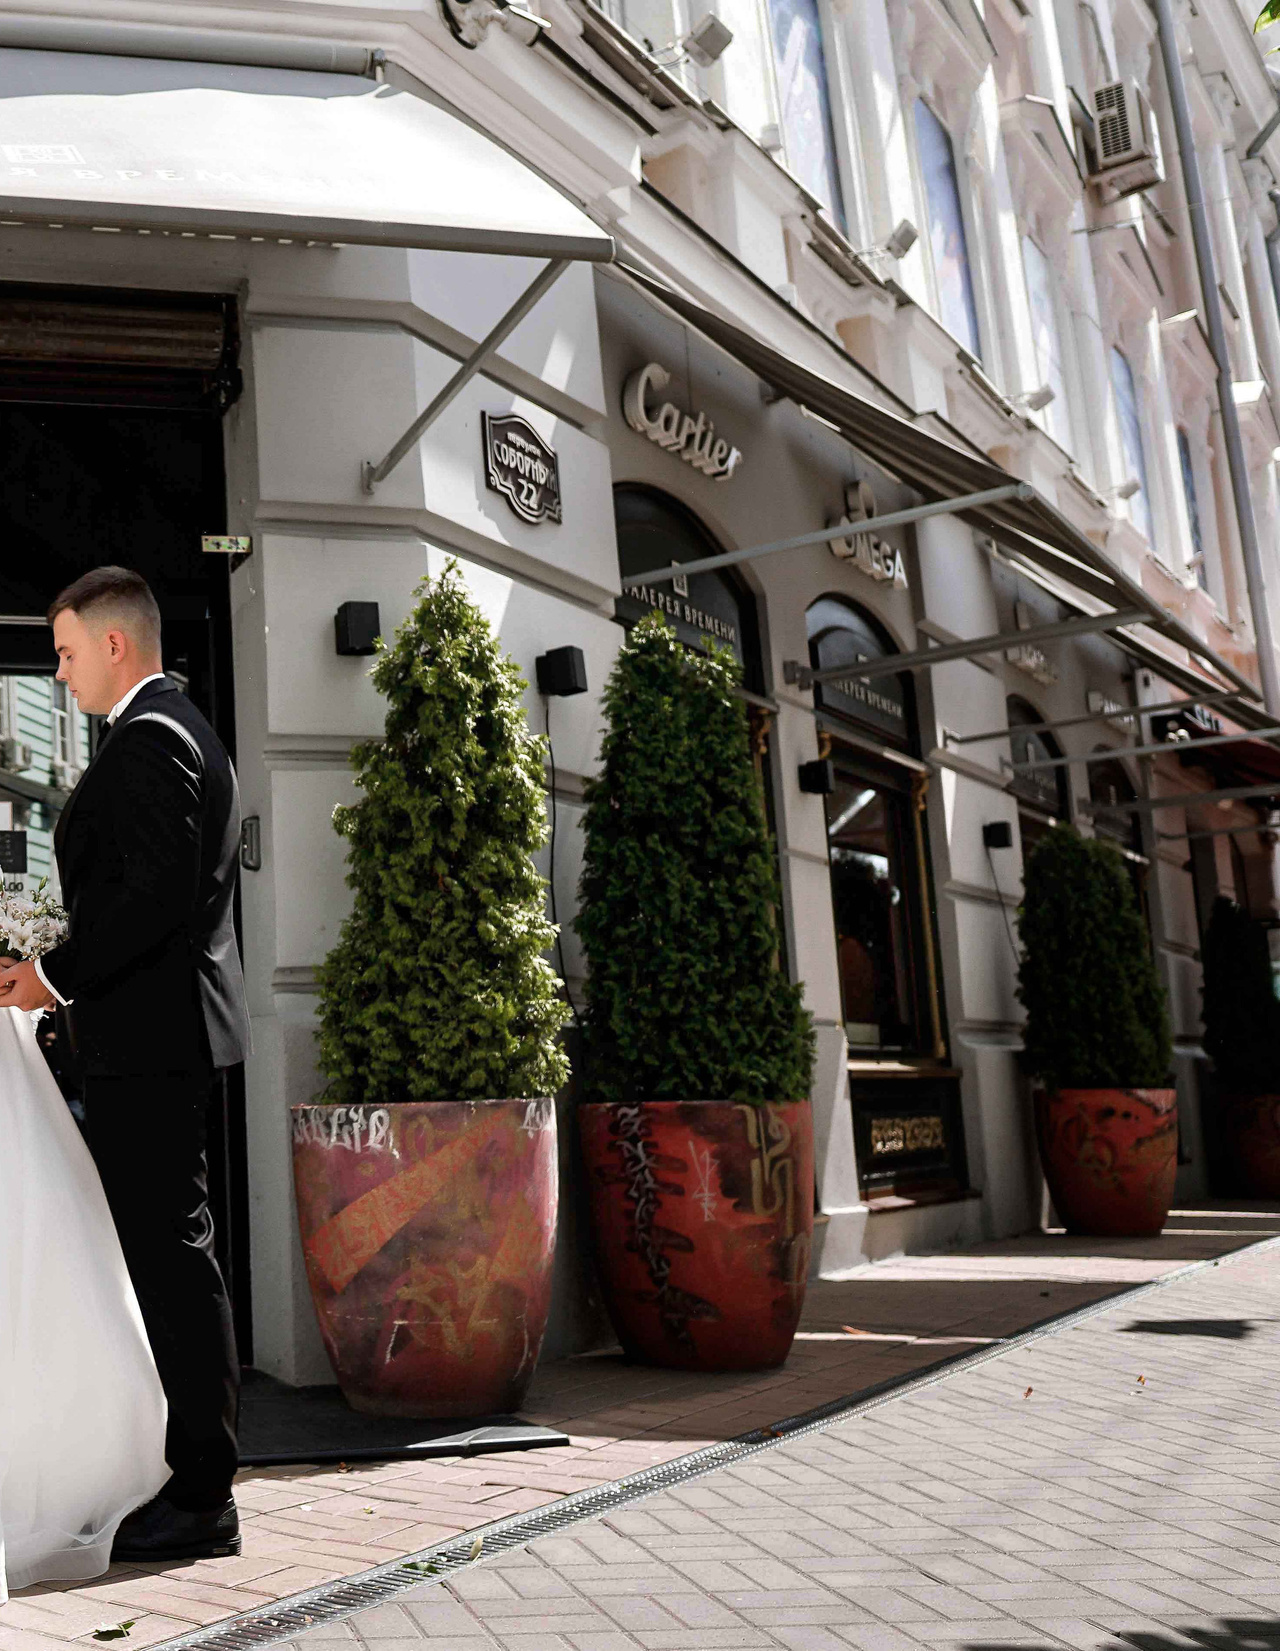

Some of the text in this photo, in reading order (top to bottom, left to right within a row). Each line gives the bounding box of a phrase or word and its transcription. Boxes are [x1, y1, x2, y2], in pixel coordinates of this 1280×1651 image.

[623, 362, 743, 481] Cartier
[517, 478, 538, 510] 22
[684, 604, 737, 642] ВРЕМЕНИ
